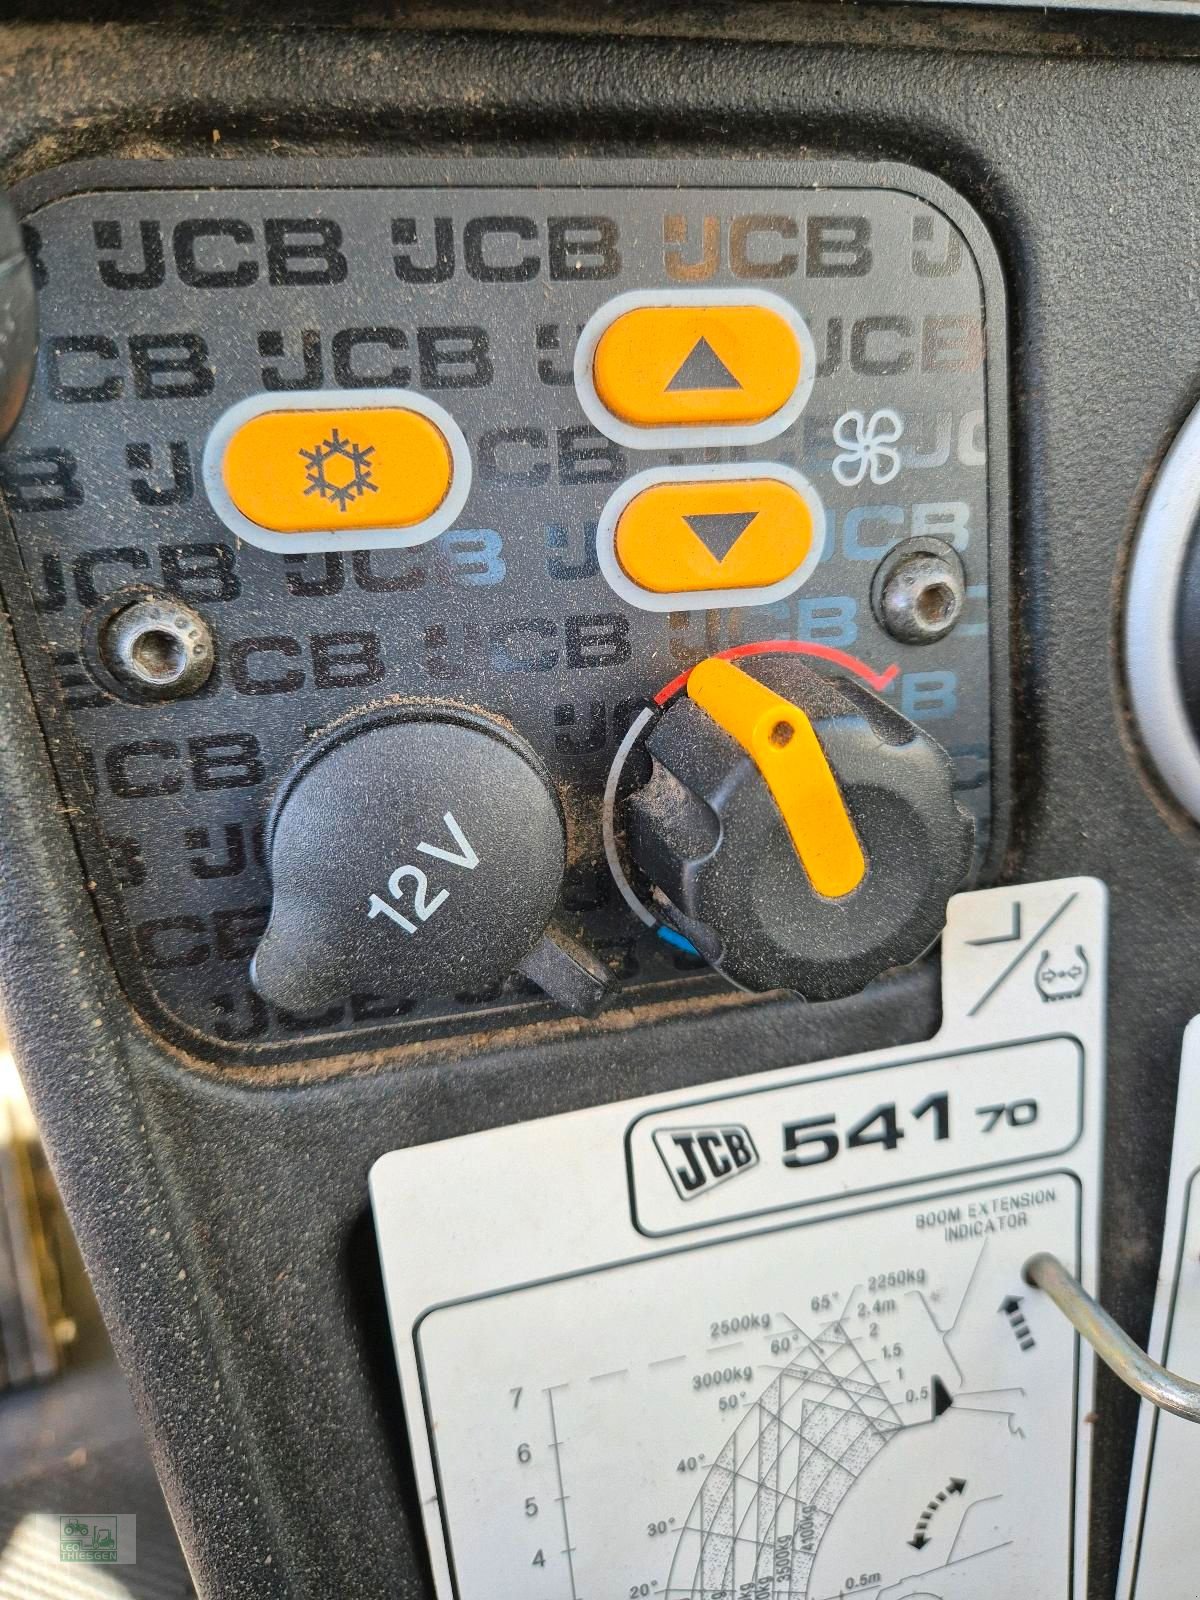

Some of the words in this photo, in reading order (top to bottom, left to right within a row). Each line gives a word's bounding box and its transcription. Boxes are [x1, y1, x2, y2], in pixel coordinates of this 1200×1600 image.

[93, 217, 348, 290] JCB
[391, 214, 622, 285] JCB
[663, 213, 873, 281] JCB
[47, 332, 215, 403] CB
[257, 326, 494, 391] JCB
[478, 424, 627, 487] CB
[423, 612, 632, 682] JCB
[229, 629, 386, 695] CB
[368, 811, 480, 934] 12V
[671, 1130, 752, 1191] JCB
[781, 1091, 950, 1169] 541
[974, 1098, 1039, 1134] 70
[915, 1207, 960, 1229] BOOM
[968, 1188, 1057, 1218] EXTENSION
[944, 1212, 1028, 1242] INDICATOR
[868, 1268, 926, 1291] 2250kg
[857, 1299, 897, 1318] 2.4m
[710, 1313, 771, 1338] 2500kg
[869, 1323, 879, 1338] 2
[882, 1342, 903, 1360] 1.5
[692, 1366, 753, 1391] 3000kg
[510, 1386, 523, 1410] 7
[905, 1387, 929, 1404] 0.5
[517, 1442, 532, 1464] 6
[524, 1496, 539, 1518] 5
[532, 1548, 546, 1568] 4
[845, 1572, 882, 1590] 0.5m
